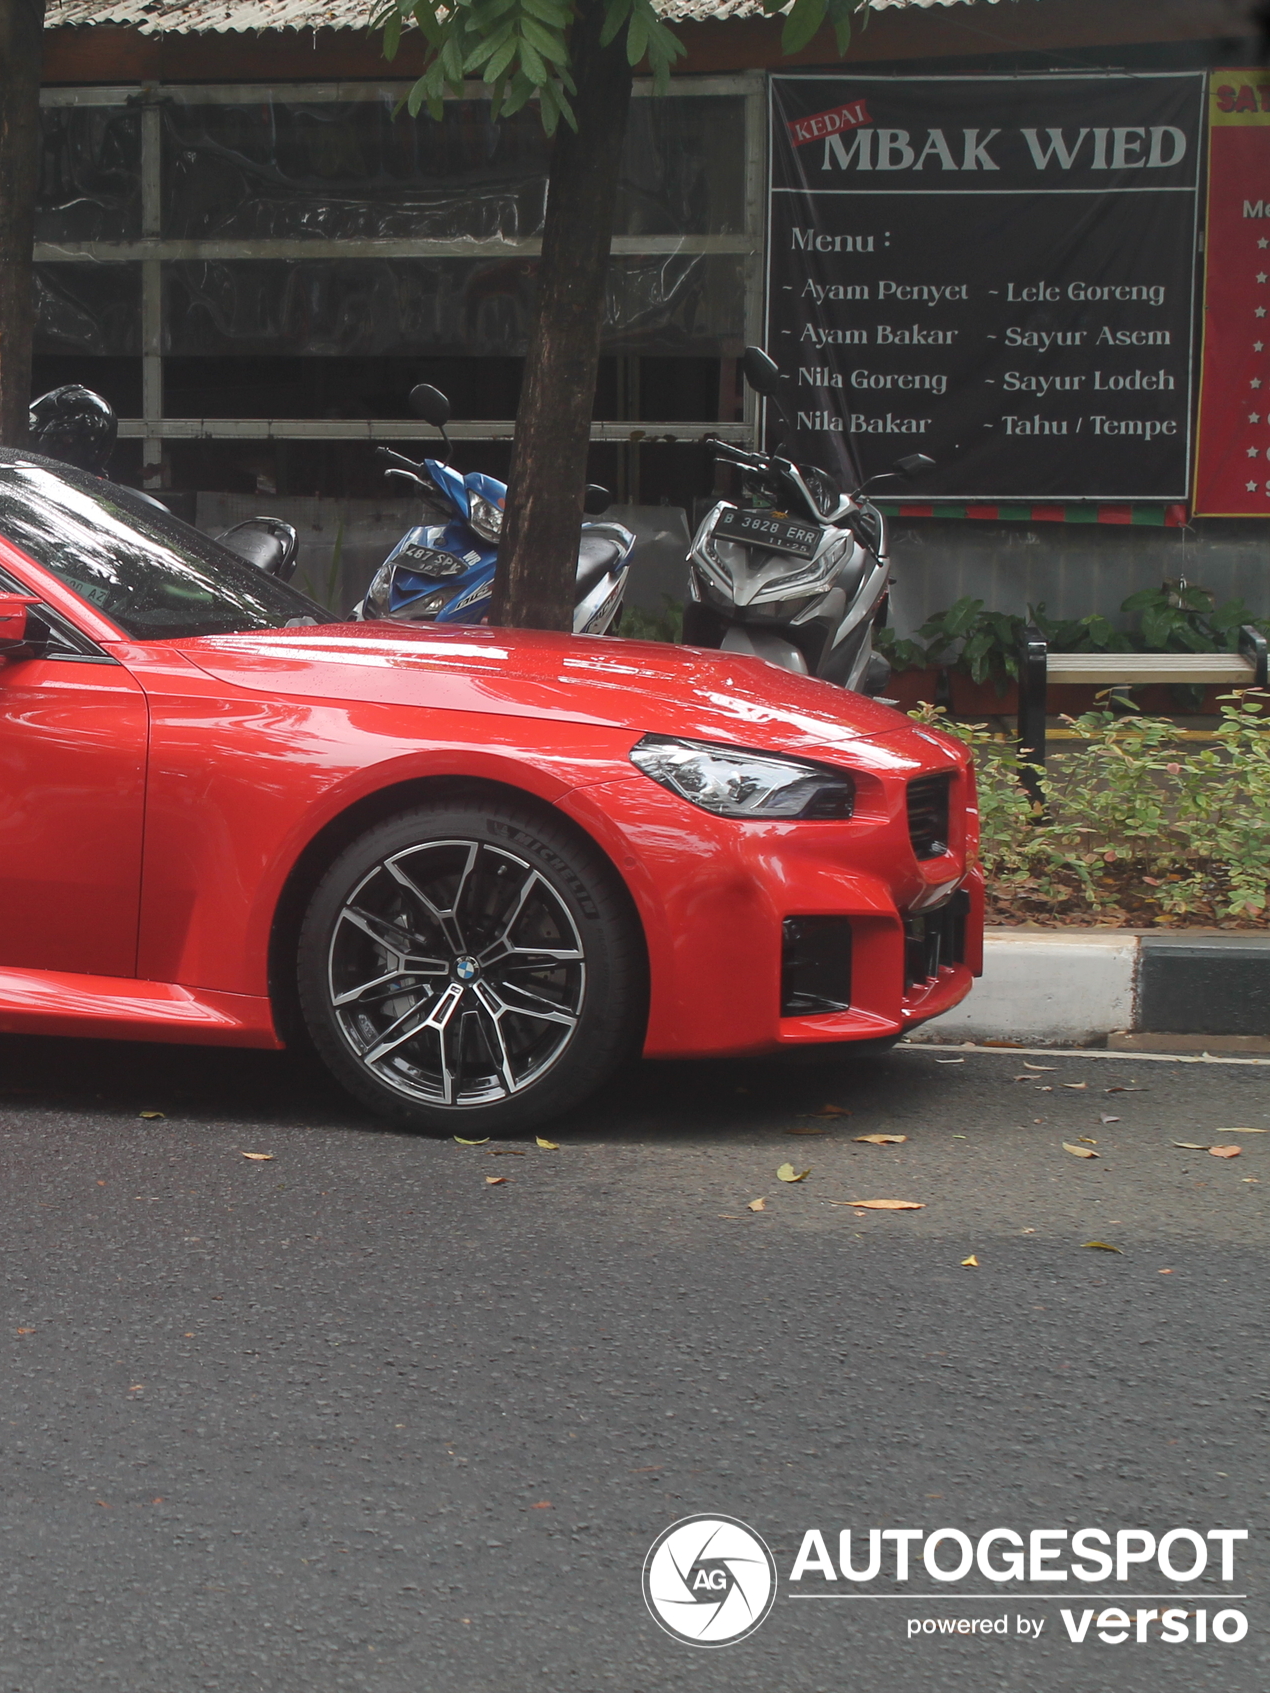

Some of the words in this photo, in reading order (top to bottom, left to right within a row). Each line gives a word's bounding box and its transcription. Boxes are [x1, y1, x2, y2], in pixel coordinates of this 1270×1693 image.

[794, 104, 865, 142] KEDAI
[821, 128, 1001, 171] MBAK
[1020, 126, 1188, 171] WIED
[791, 228, 876, 253] Menu
[801, 279, 870, 305] Ayam
[878, 280, 969, 307] Penyet
[1007, 281, 1061, 302] Lele
[1068, 281, 1166, 306] Goreng
[800, 323, 868, 349] Ayam
[876, 324, 959, 345] Bakar
[1004, 326, 1088, 353] Sayur
[1096, 326, 1171, 346] Asem
[798, 367, 843, 388] Nila
[851, 369, 948, 395] Goreng
[1003, 371, 1086, 397] Sayur
[1093, 369, 1175, 391] Lodeh
[796, 410, 844, 432] Nila
[850, 412, 932, 434] Bakar
[1002, 414, 1068, 435] Tahu
[1090, 415, 1177, 441] Tempe
[723, 513, 735, 524] B
[741, 517, 780, 533] 3828
[786, 526, 816, 543] ERR
[514, 831, 598, 913] MICHELIN
